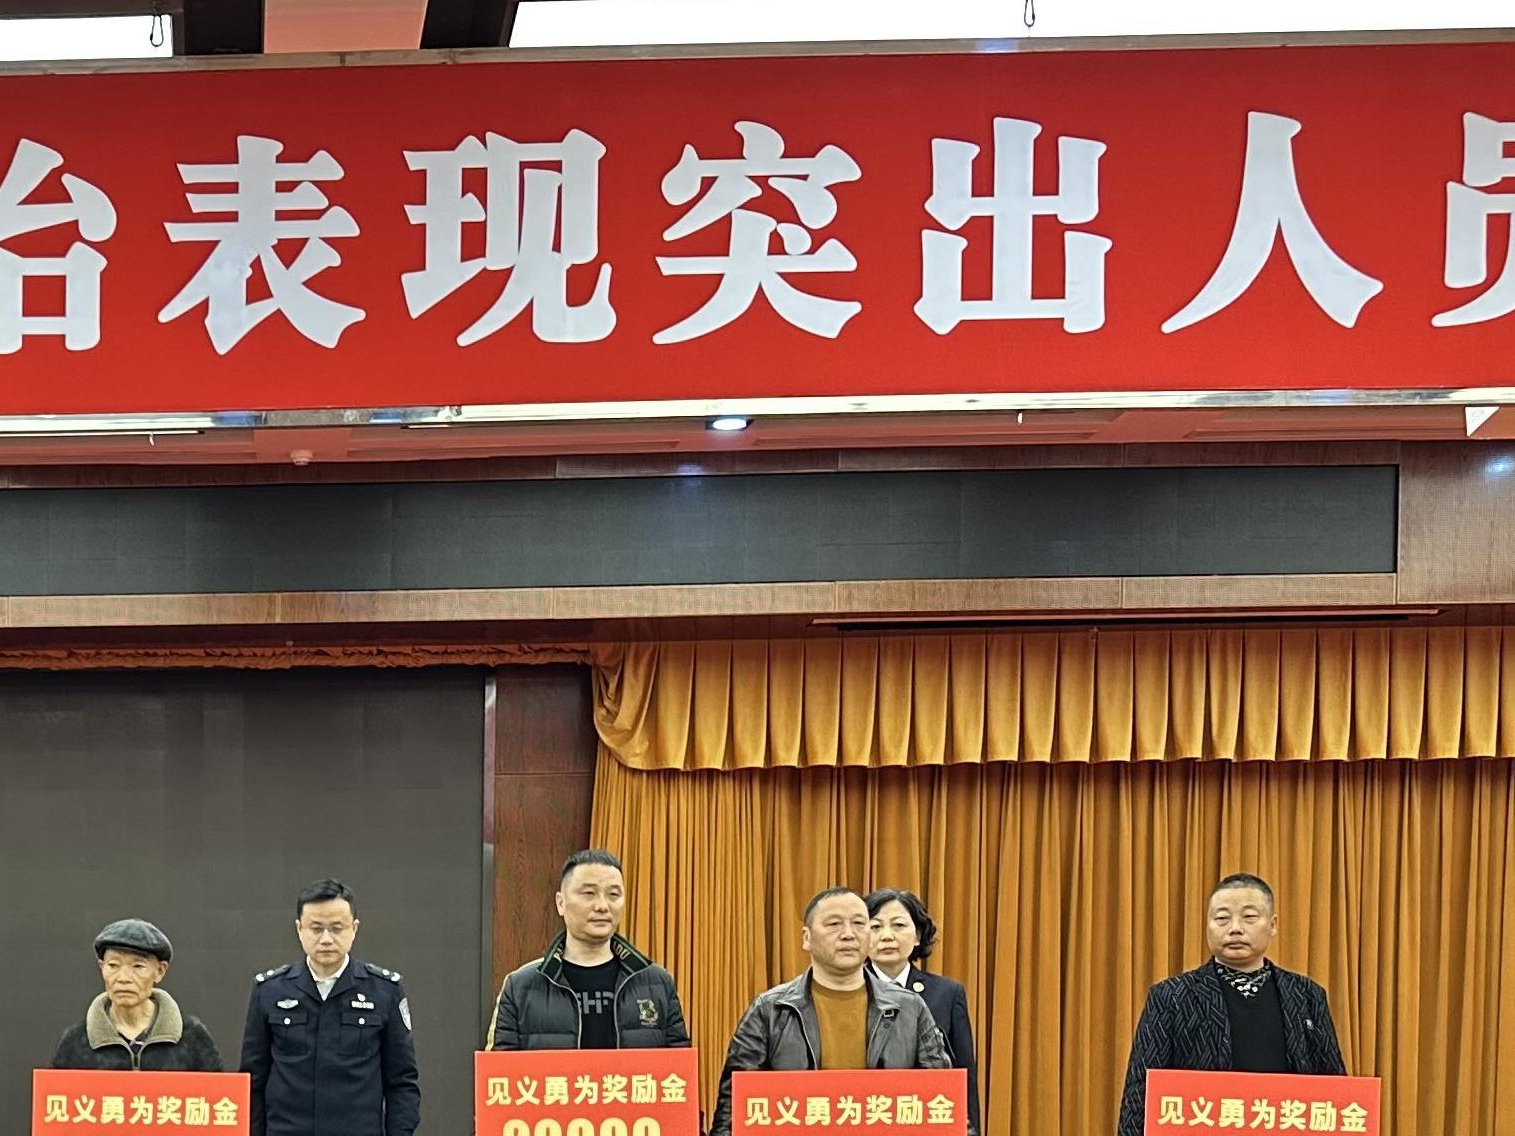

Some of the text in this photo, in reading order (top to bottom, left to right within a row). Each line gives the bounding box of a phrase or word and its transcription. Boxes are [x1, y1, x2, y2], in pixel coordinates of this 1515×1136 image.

[485, 1073, 687, 1105] 见义勇为奖励金
[44, 1095, 238, 1126] 见义勇为奖励金
[744, 1095, 954, 1125] 见义勇为奖励金
[1158, 1097, 1367, 1132] 见义勇为奖励金
